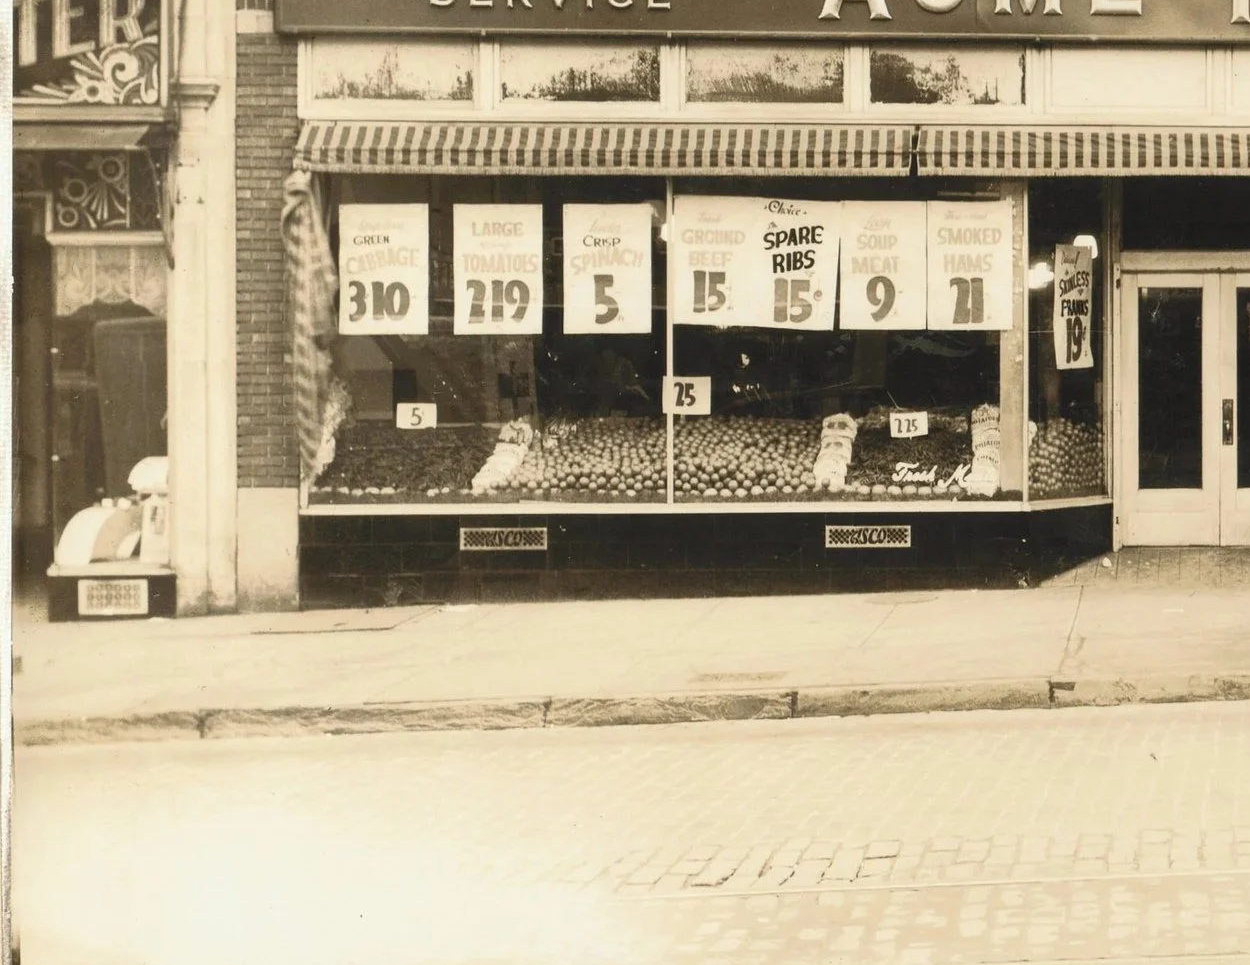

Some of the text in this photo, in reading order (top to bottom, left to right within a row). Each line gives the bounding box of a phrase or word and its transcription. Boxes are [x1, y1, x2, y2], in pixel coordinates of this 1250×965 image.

[767, 200, 802, 216] Choice
[472, 222, 524, 237] LARGE
[681, 228, 747, 246] GROUND
[763, 225, 824, 250] SPARE
[937, 227, 1002, 246] SMOKED
[353, 235, 390, 246] GREEN
[856, 234, 898, 250] SOUP
[346, 246, 421, 275] CABBAGE
[461, 253, 538, 273] TOMATOES
[569, 246, 643, 276] SPINACH
[688, 250, 733, 267] BEEF
[772, 250, 816, 274] RIBS
[851, 255, 901, 274] MEAT
[942, 253, 994, 273] HAMS
[1059, 271, 1091, 297] SKINLESS
[593, 274, 620, 325] 5
[866, 275, 896, 323] 9
[949, 277, 985, 324] 21
[1061, 298, 1089, 317] FRANKS
[674, 381, 697, 407] 25
[485, 529, 523, 548] ASCO
[850, 527, 887, 545] ASCO
